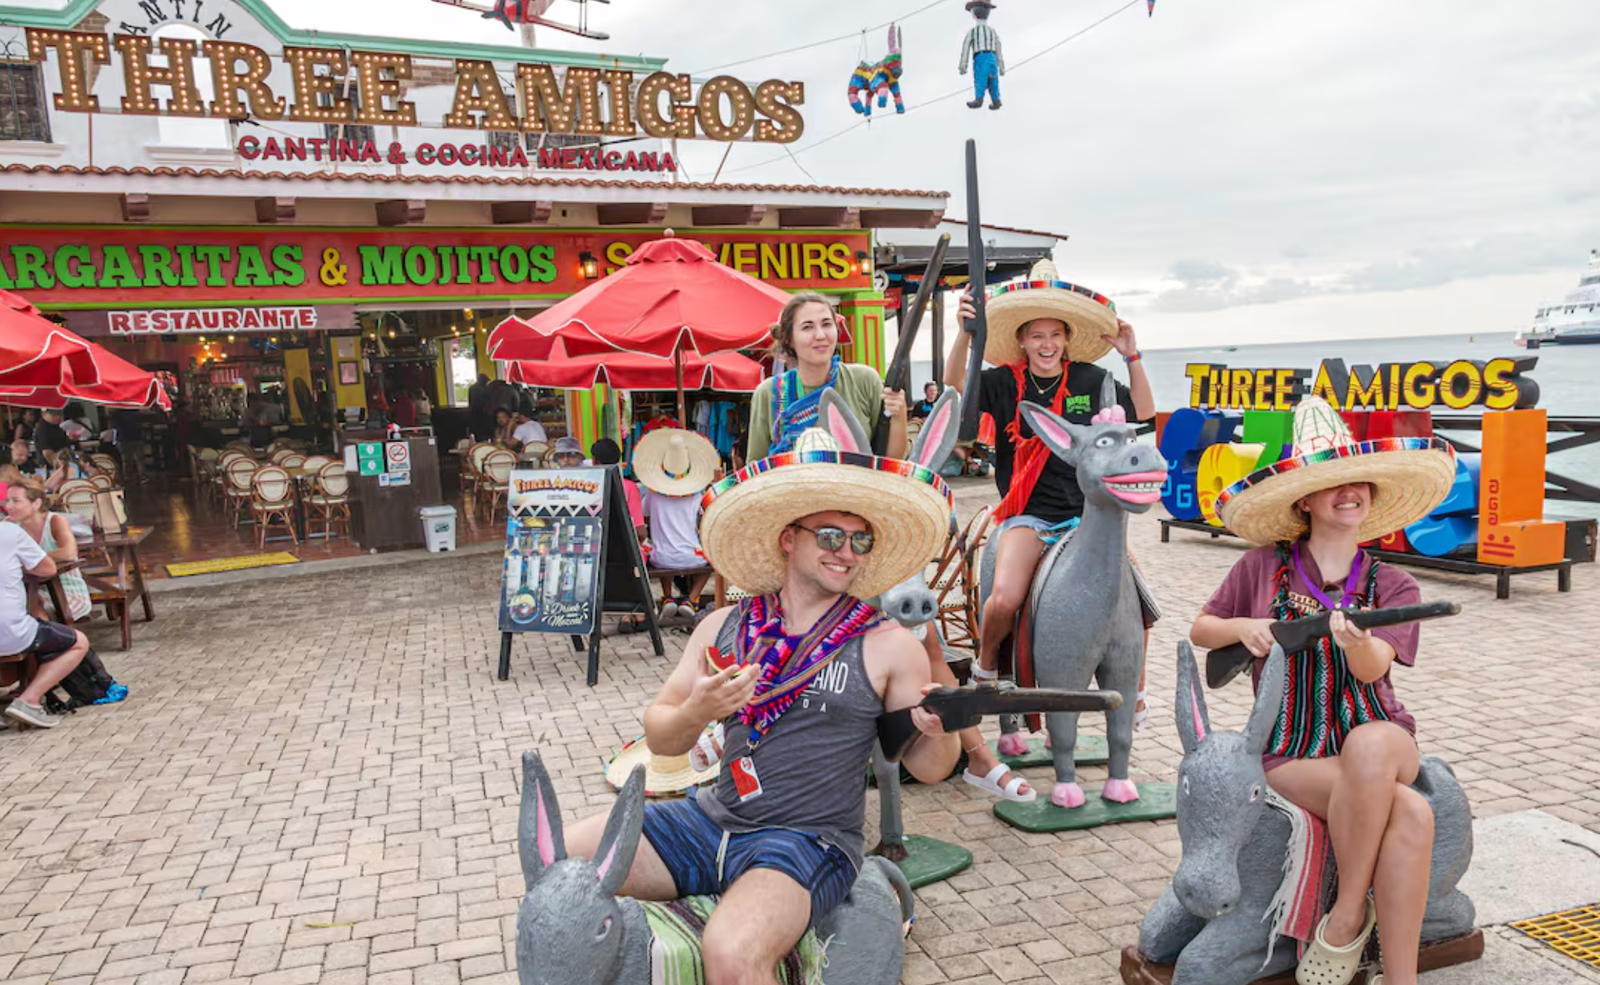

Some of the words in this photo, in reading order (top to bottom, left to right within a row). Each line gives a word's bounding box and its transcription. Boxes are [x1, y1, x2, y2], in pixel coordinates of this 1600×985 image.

[26, 28, 416, 126] THREE
[446, 58, 804, 143] AMIGOS
[238, 135, 381, 162] CANTINA
[387, 141, 408, 165] &
[415, 142, 529, 168] COCINA
[537, 146, 677, 172] MEXICANA
[319, 247, 348, 285] &
[359, 244, 557, 285] MOJITOS
[606, 240, 852, 279] SENIRS
[109, 307, 317, 335] RESTAURANTE
[1185, 363, 1295, 412] THREE
[1311, 357, 1520, 412] AMIGOS
[513, 479, 550, 495] THREE
[551, 474, 600, 494] AMIGOS
